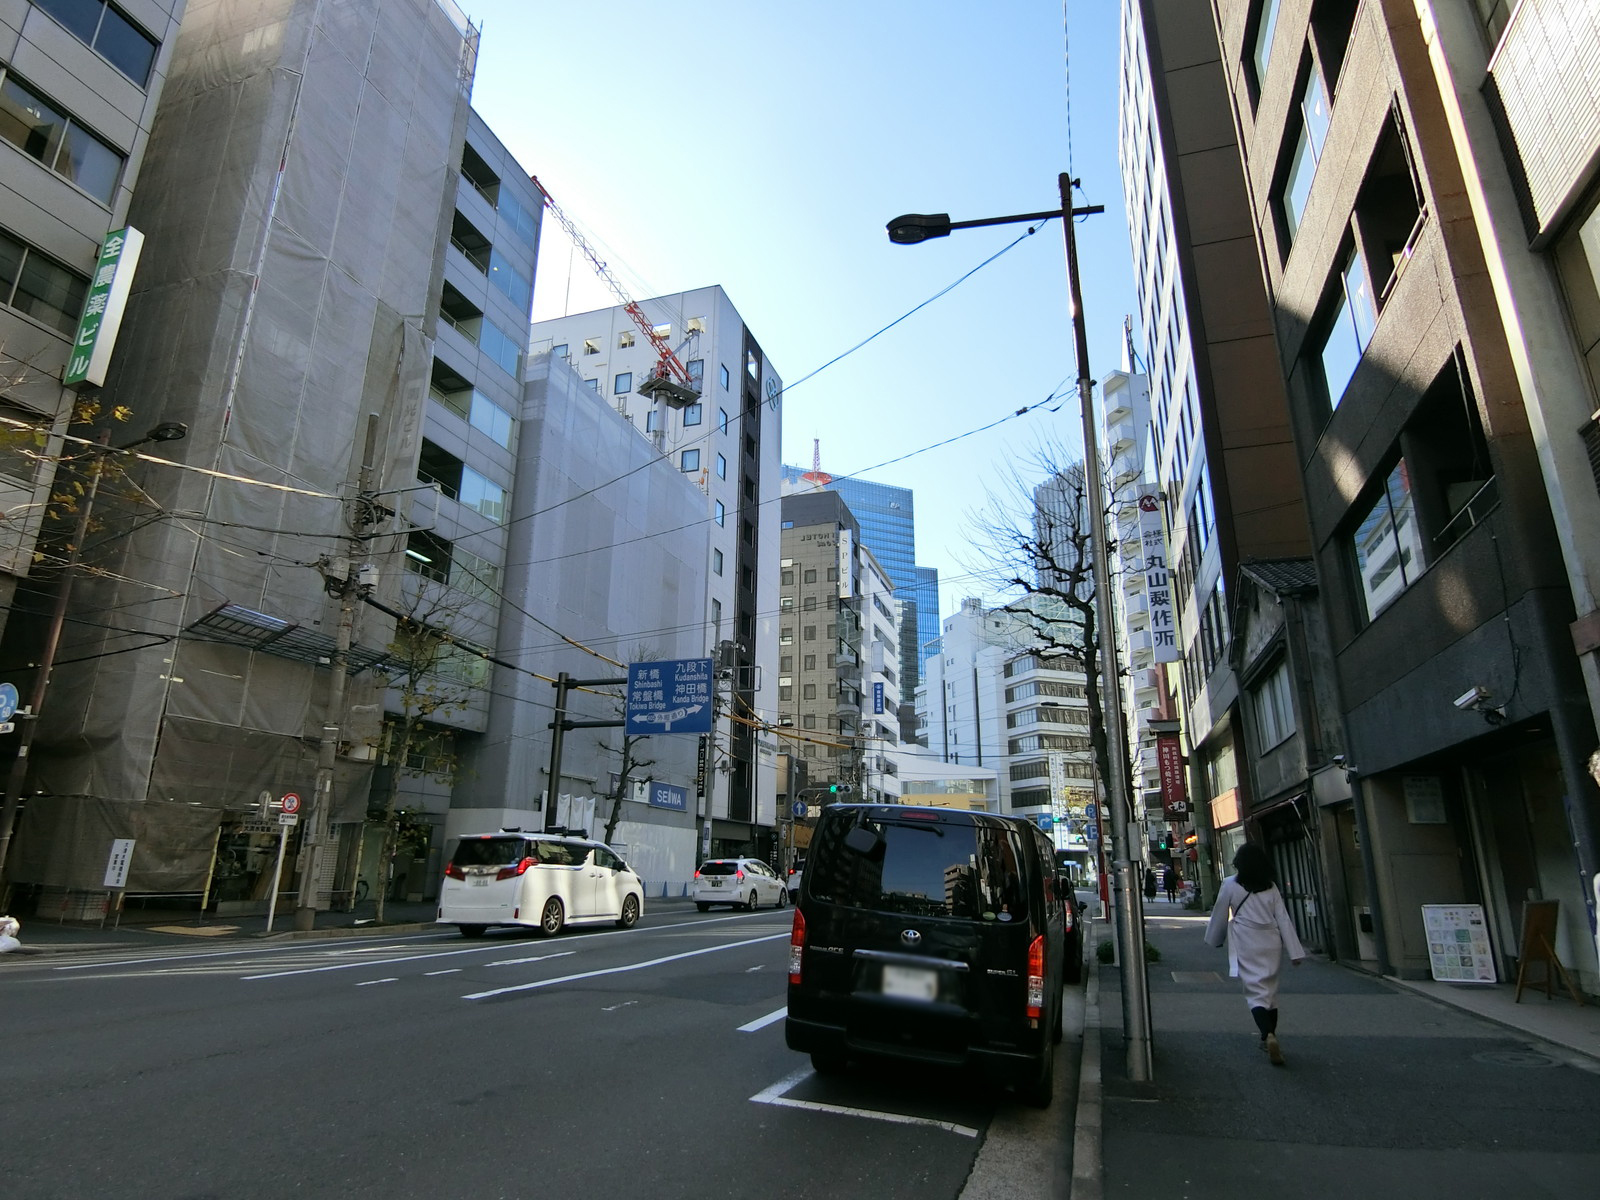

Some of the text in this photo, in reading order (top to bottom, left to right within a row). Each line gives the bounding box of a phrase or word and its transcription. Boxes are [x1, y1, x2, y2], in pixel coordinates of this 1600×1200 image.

[69, 236, 124, 378] 全農薬ビル
[1146, 555, 1174, 647] 丸山製作所
[675, 661, 708, 673] 九段下
[637, 669, 660, 680] 新橋
[674, 673, 708, 682] Kudanshita
[634, 680, 663, 689] Shinbashi
[675, 683, 707, 695] 神田橋
[632, 690, 664, 702] 常盤橋
[691, 695, 709, 704] Bridge
[629, 702, 666, 710] Tokiwa Bridge
